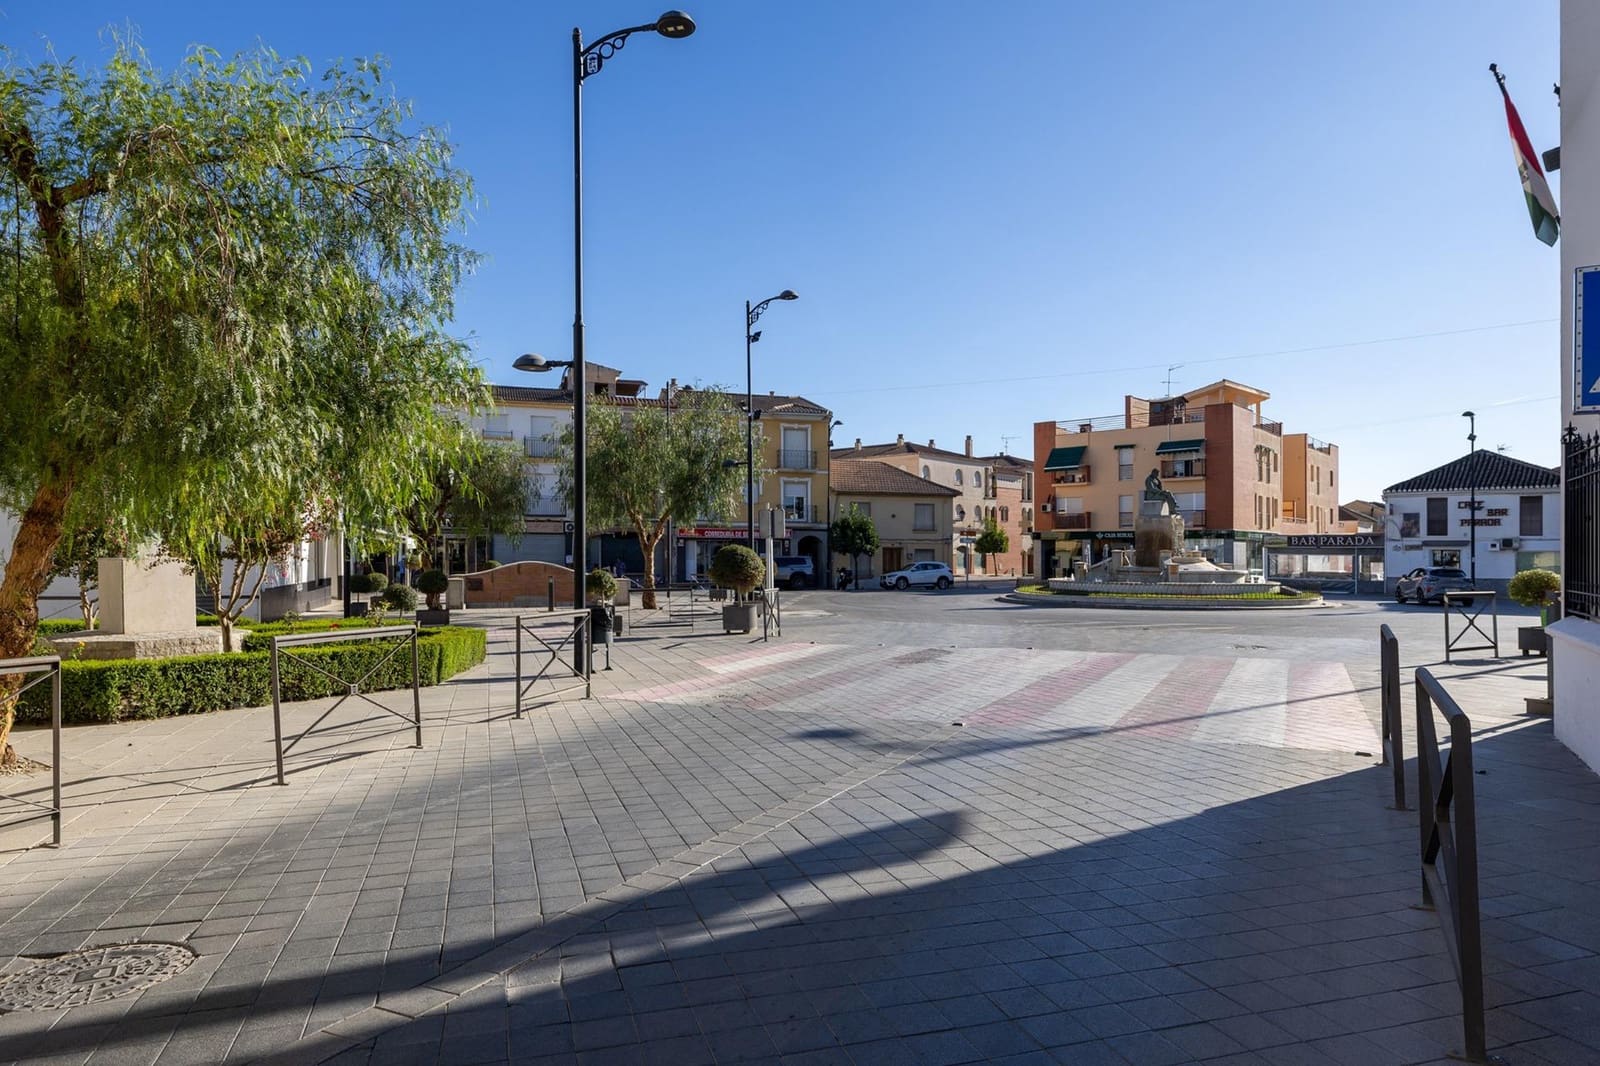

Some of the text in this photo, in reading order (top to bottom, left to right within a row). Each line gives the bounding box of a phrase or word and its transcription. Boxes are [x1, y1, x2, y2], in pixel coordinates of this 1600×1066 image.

[1487, 508, 1508, 517] BAR
[1291, 536, 1375, 546] BAR PARADA
